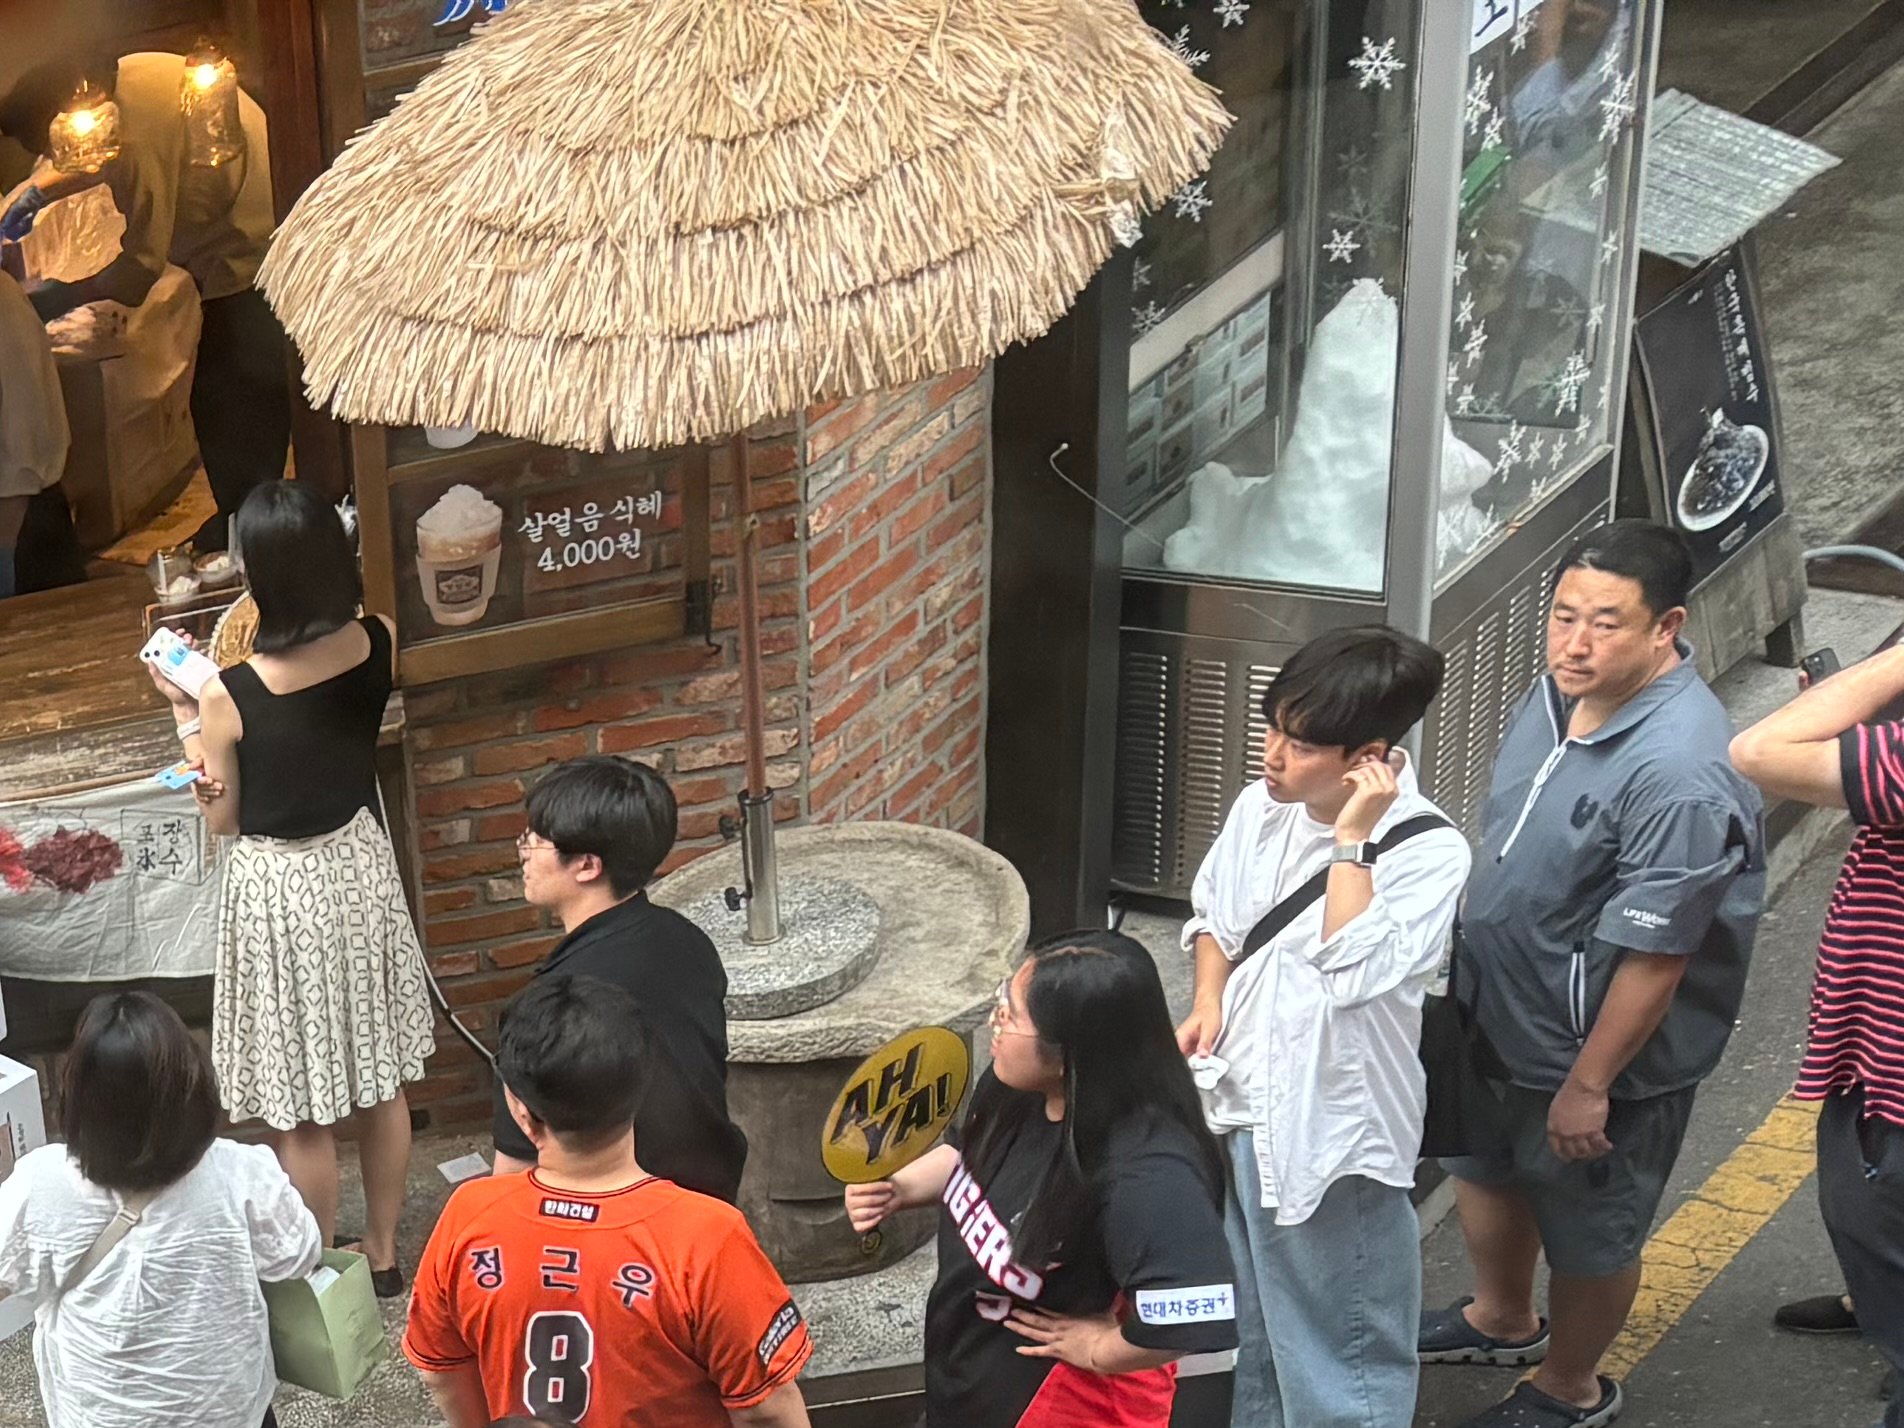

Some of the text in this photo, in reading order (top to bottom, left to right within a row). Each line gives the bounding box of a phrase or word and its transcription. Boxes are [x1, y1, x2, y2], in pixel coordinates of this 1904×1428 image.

[517, 490, 662, 543] 살얼음 식혜
[537, 528, 641, 571] 4,000원
[830, 1043, 923, 1143] AH
[861, 1075, 952, 1167] YA!
[943, 1156, 1044, 1301] IGERS
[468, 1245, 657, 1309] 정근우
[523, 1310, 595, 1425] 8
